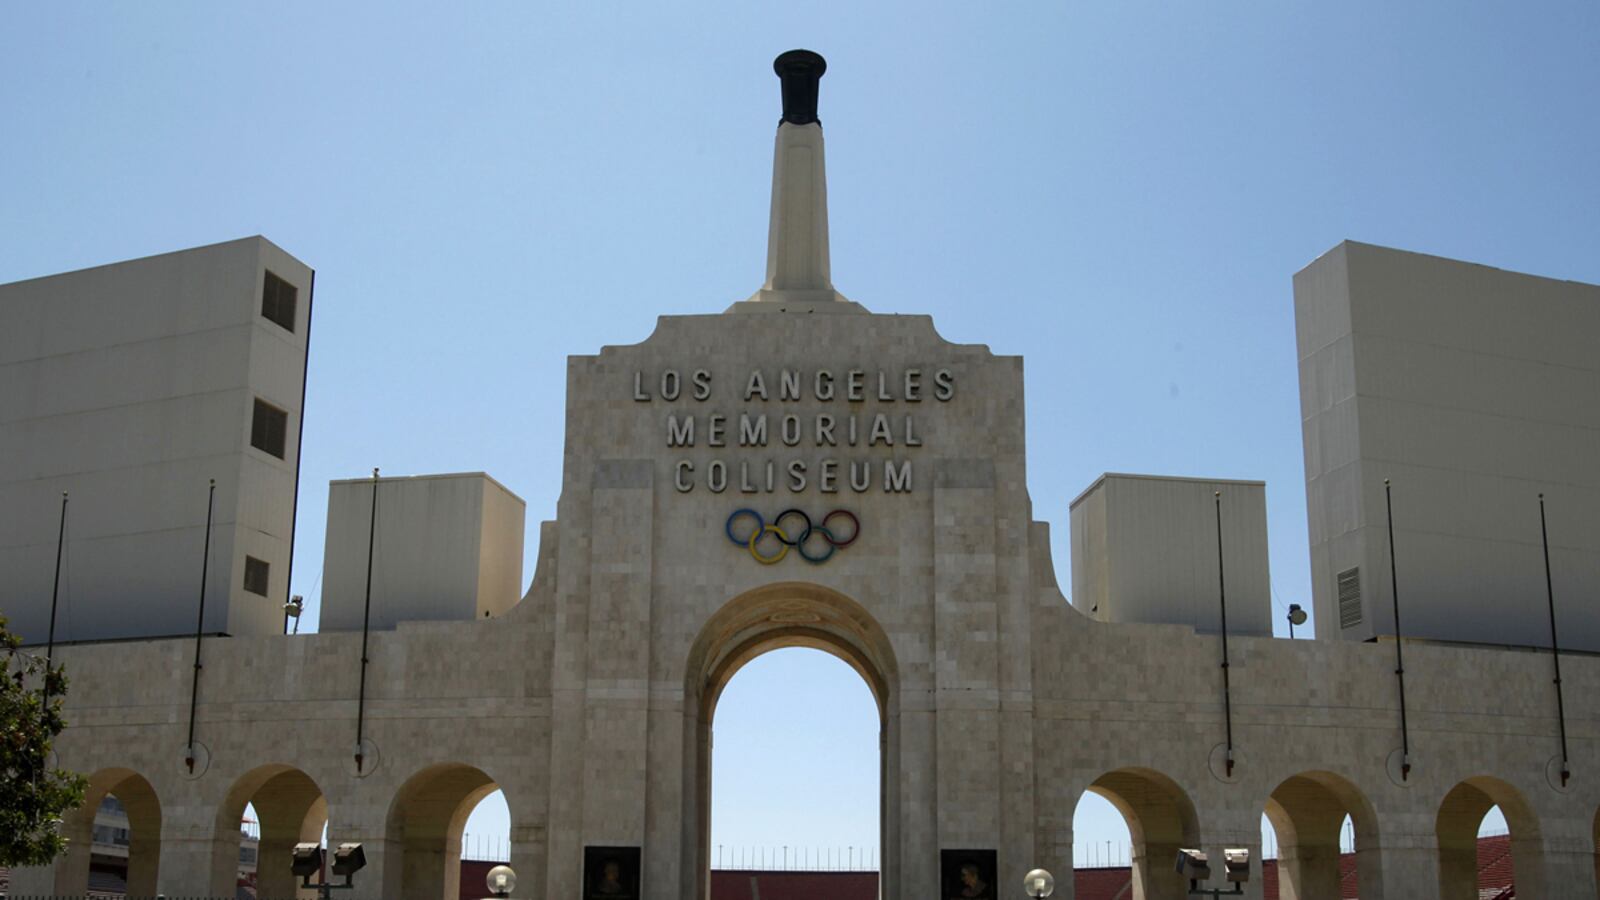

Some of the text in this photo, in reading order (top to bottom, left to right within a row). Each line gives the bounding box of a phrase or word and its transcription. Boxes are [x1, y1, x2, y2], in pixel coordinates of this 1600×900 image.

[633, 368, 955, 401] LOS ANGELES
[667, 413, 922, 447] MEMORIAL
[674, 459, 913, 494] COLISEUM
